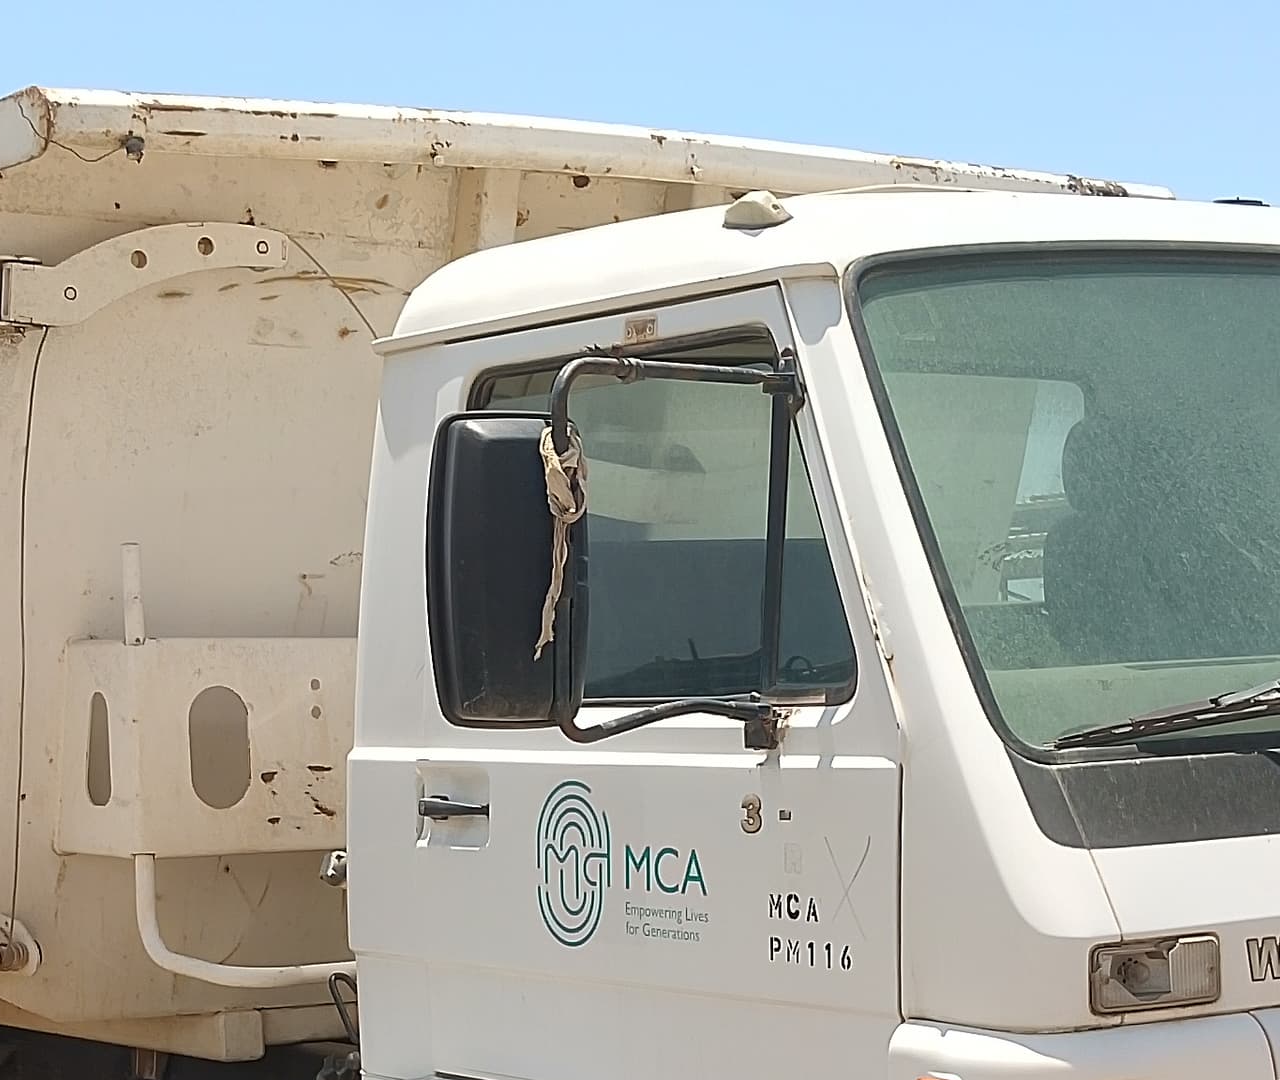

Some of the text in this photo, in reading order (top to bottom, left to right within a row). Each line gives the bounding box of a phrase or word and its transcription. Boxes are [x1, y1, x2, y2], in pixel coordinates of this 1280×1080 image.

[624, 844, 708, 897] MCA
[625, 901, 709, 925] Empowering Lives
[769, 893, 819, 923] MCA
[625, 922, 700, 941] for Generations
[770, 936, 852, 970] PM116
